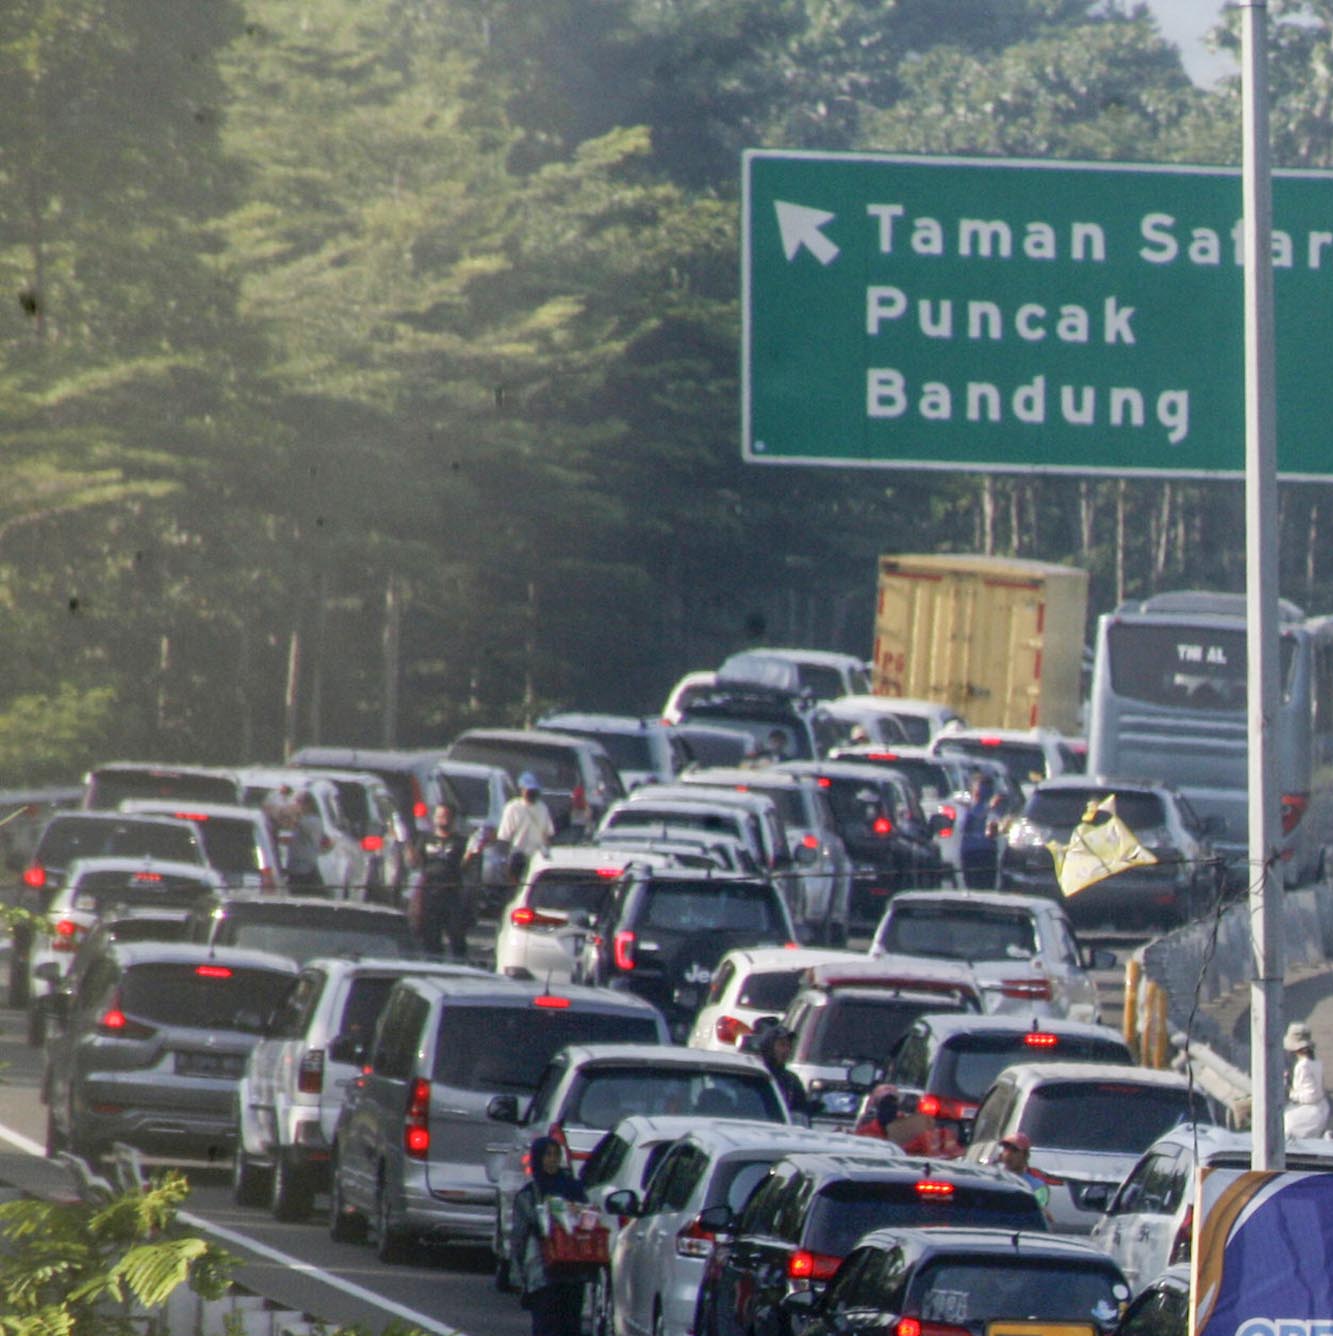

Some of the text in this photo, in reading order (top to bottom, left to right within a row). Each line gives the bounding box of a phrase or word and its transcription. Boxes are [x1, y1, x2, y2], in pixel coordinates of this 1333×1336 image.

[866, 203, 1106, 261] Taman
[867, 285, 1136, 345] Puncak
[867, 367, 1190, 444] Bandung
